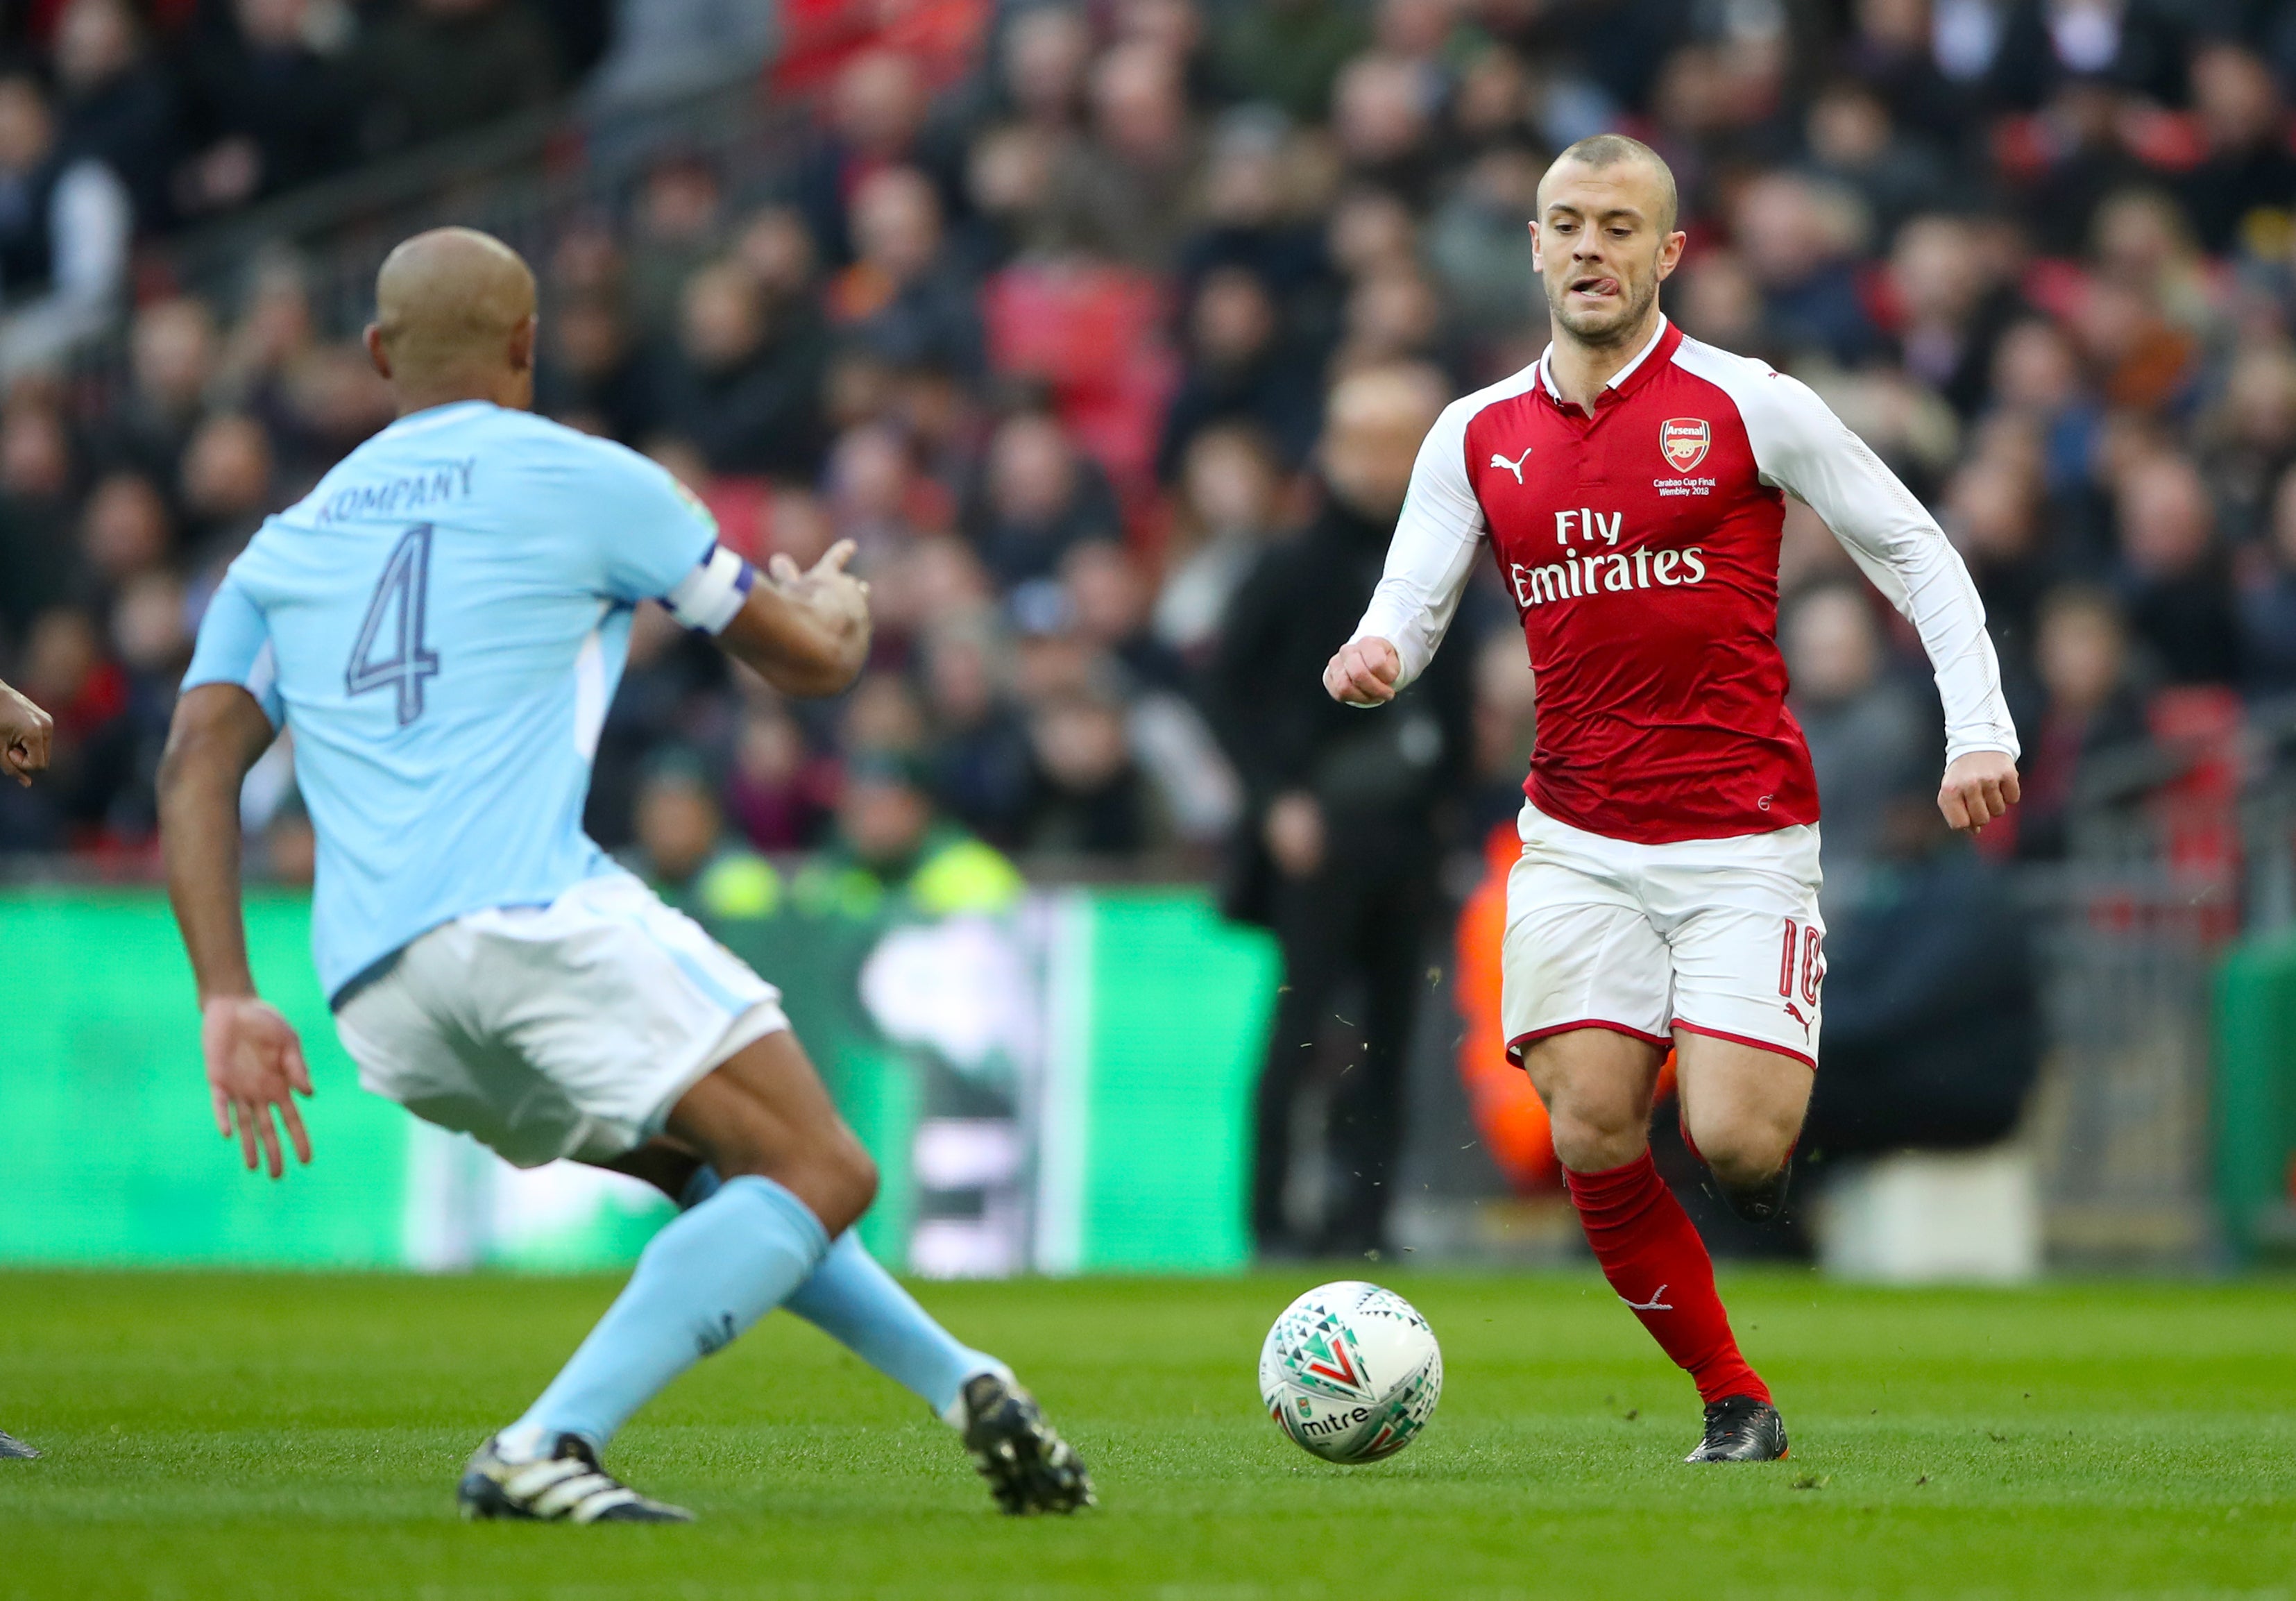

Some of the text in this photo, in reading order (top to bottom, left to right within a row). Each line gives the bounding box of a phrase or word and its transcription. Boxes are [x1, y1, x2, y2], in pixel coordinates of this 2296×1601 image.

[1667, 425, 1703, 435] Arsenal
[316, 457, 475, 523] KOMPANY
[1659, 487, 1690, 497] Wembley
[1683, 477, 1697, 488] Cup
[1699, 477, 1715, 486] Final
[1554, 507, 1622, 546] Fly
[1510, 545, 1707, 608] Emirates
[345, 522, 439, 728] 4
[1778, 917, 1824, 1008] 10
[1302, 1407, 1369, 1436] mitre
